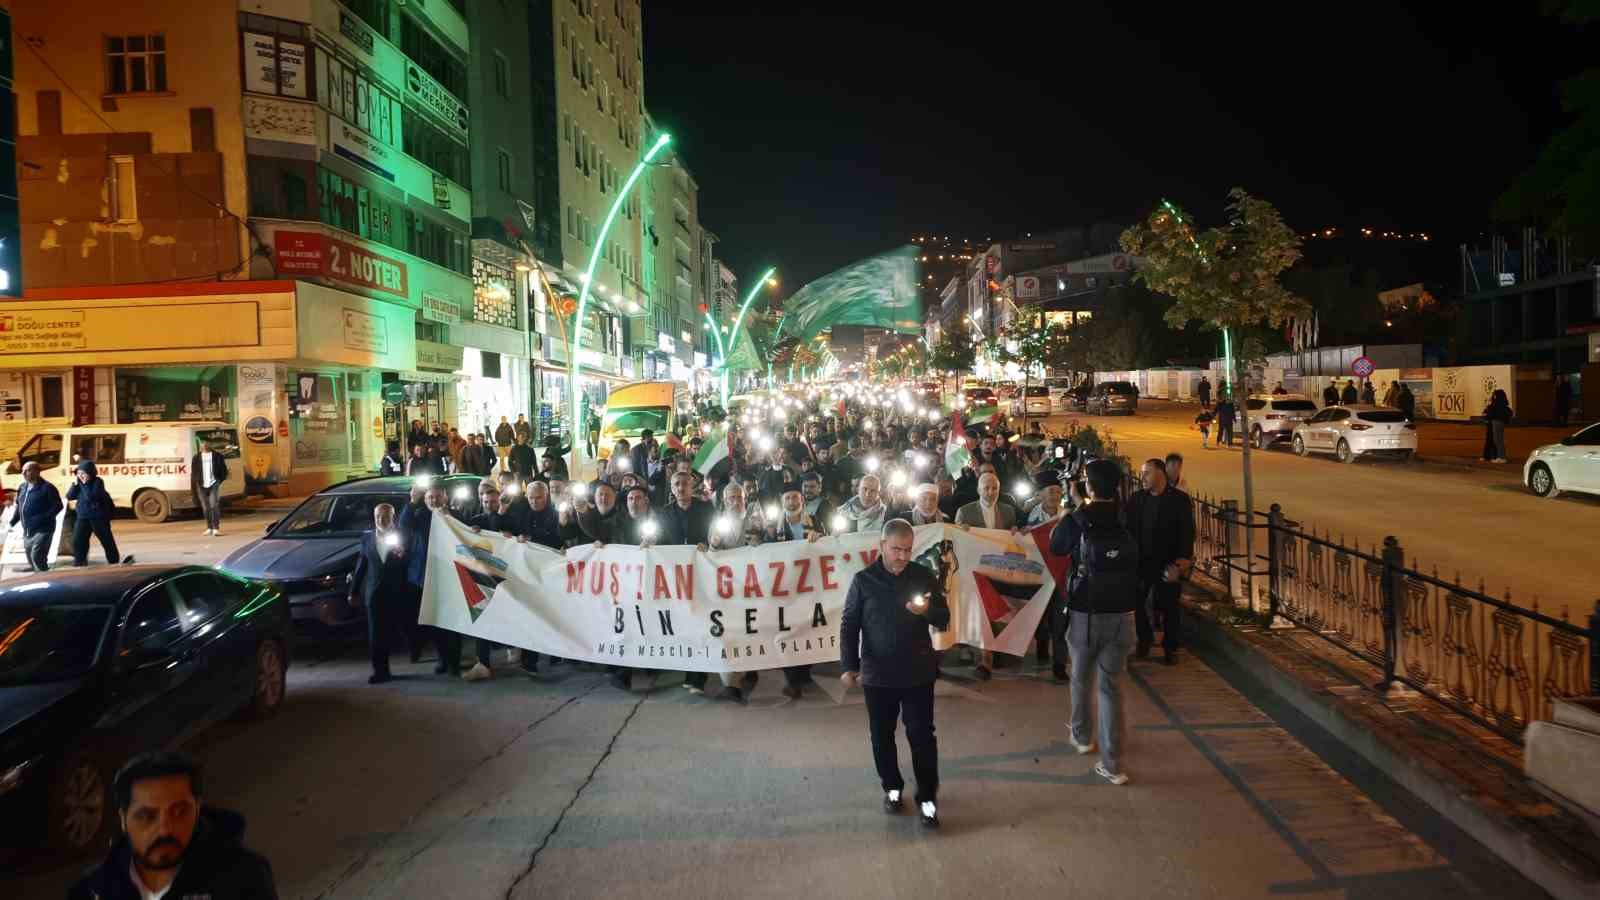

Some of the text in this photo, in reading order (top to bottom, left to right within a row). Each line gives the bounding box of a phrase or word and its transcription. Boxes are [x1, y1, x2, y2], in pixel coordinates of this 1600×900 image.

[330, 245, 347, 275] 2.
[350, 251, 402, 291] NOTER
[80, 380, 89, 424] NOTE
[113, 464, 188, 478] POŞETÇİLİK
[614, 601, 828, 638] BİN SELA
[781, 636, 836, 653] PLATF
